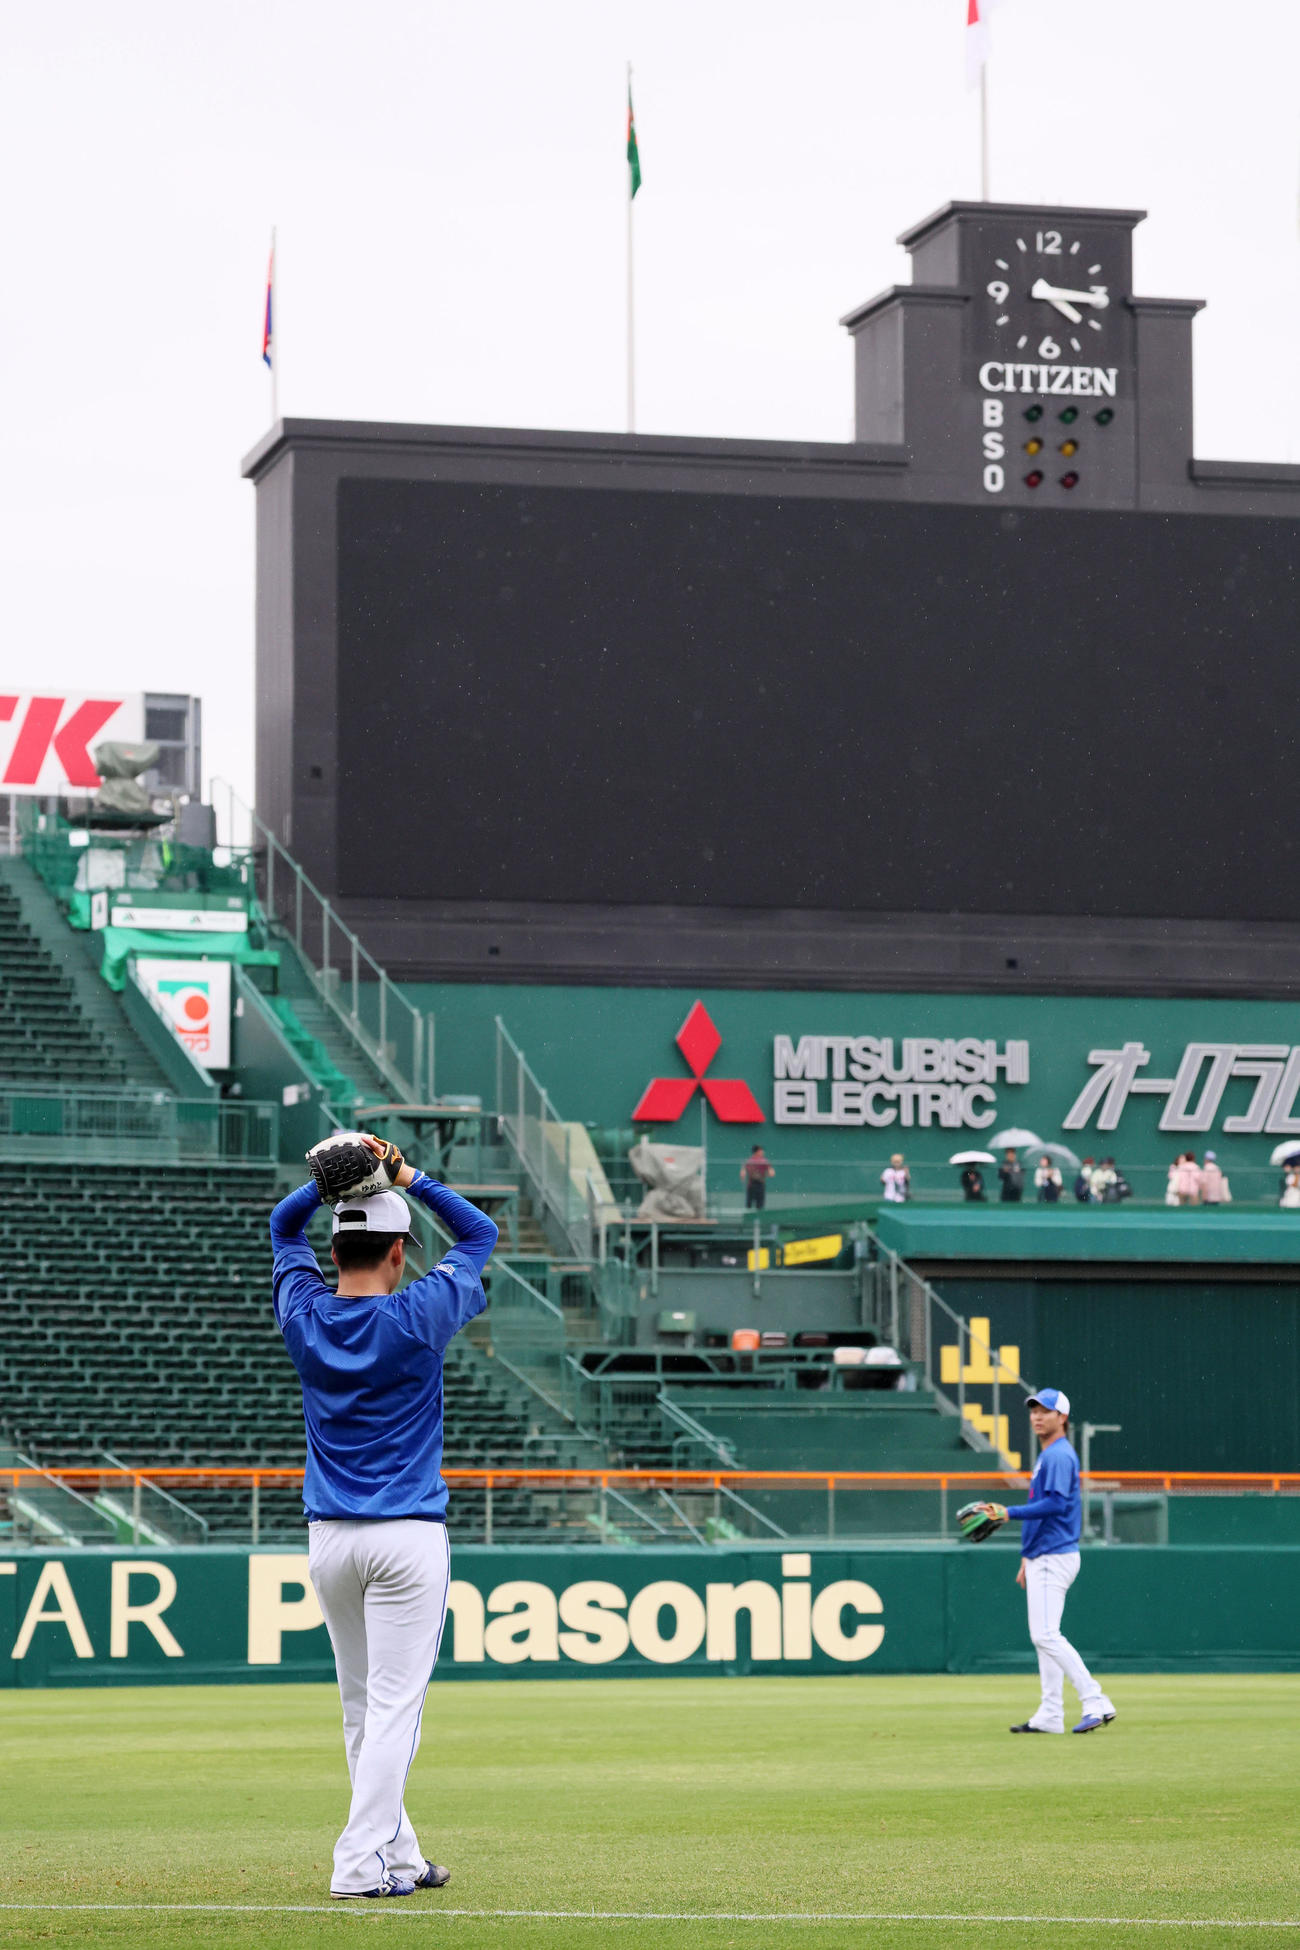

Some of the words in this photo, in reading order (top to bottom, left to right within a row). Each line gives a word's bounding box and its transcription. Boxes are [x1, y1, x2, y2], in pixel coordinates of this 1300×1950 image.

[1035, 230, 1062, 255] 12
[986, 280, 1010, 305] 9
[1037, 335, 1062, 360] 6
[978, 361, 1119, 397] CITIZEN
[982, 398, 1004, 428] B
[982, 431, 1006, 461] S
[773, 1034, 1030, 1085] MITSUBISHI
[773, 1081, 998, 1129] ELECTRIC
[0, 1560, 185, 1660] AR
[247, 1552, 886, 1665] Pnasonic
